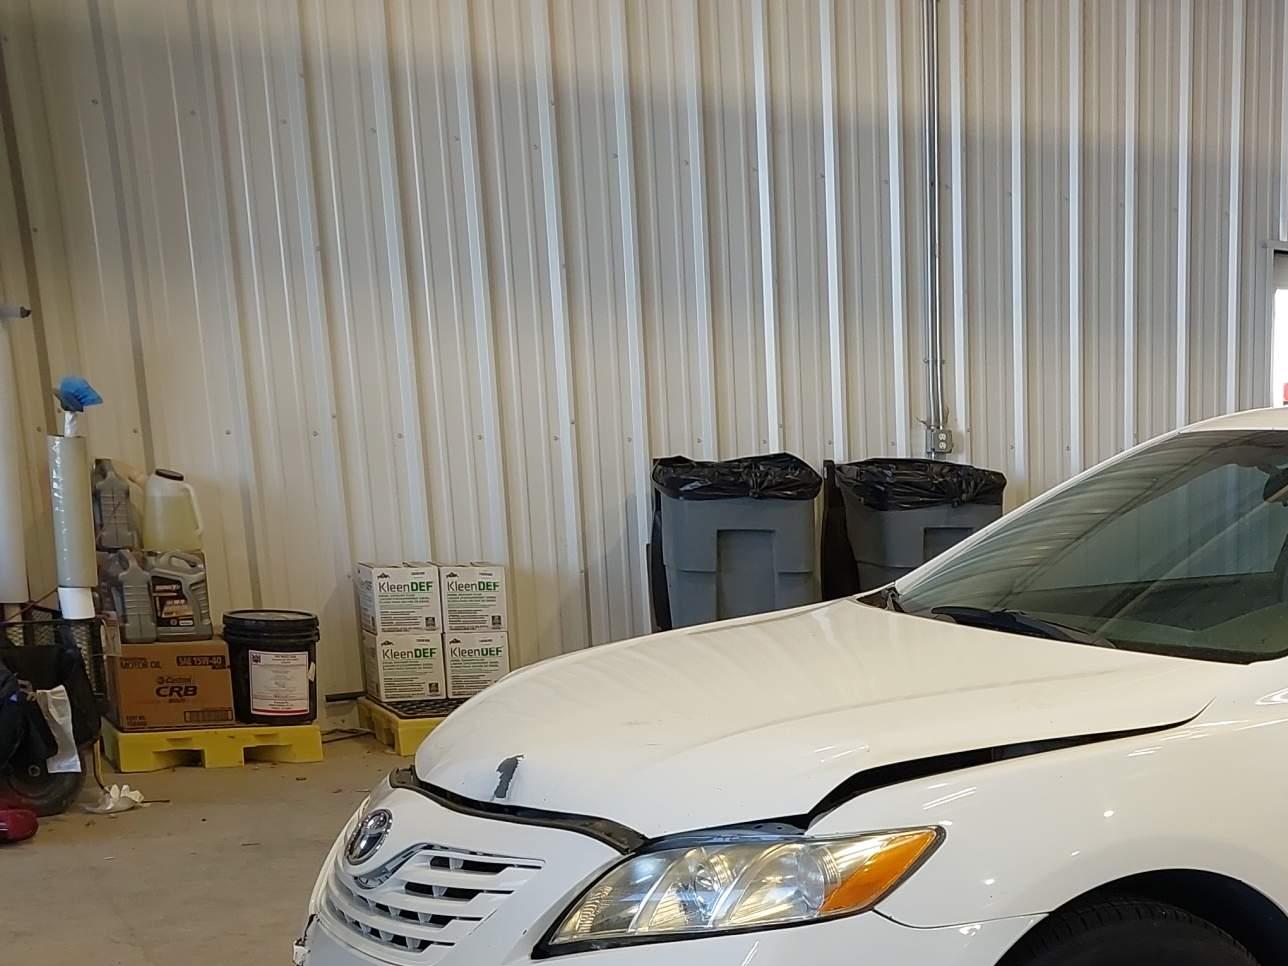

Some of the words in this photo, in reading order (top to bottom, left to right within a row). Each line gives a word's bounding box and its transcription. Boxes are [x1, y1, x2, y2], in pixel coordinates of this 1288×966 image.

[378, 581, 433, 593] KleenDEF
[447, 581, 499, 592] KleenDEF
[382, 647, 437, 659] KleenDEF
[450, 646, 502, 658] KleenDEF
[155, 685, 198, 697] CRB
